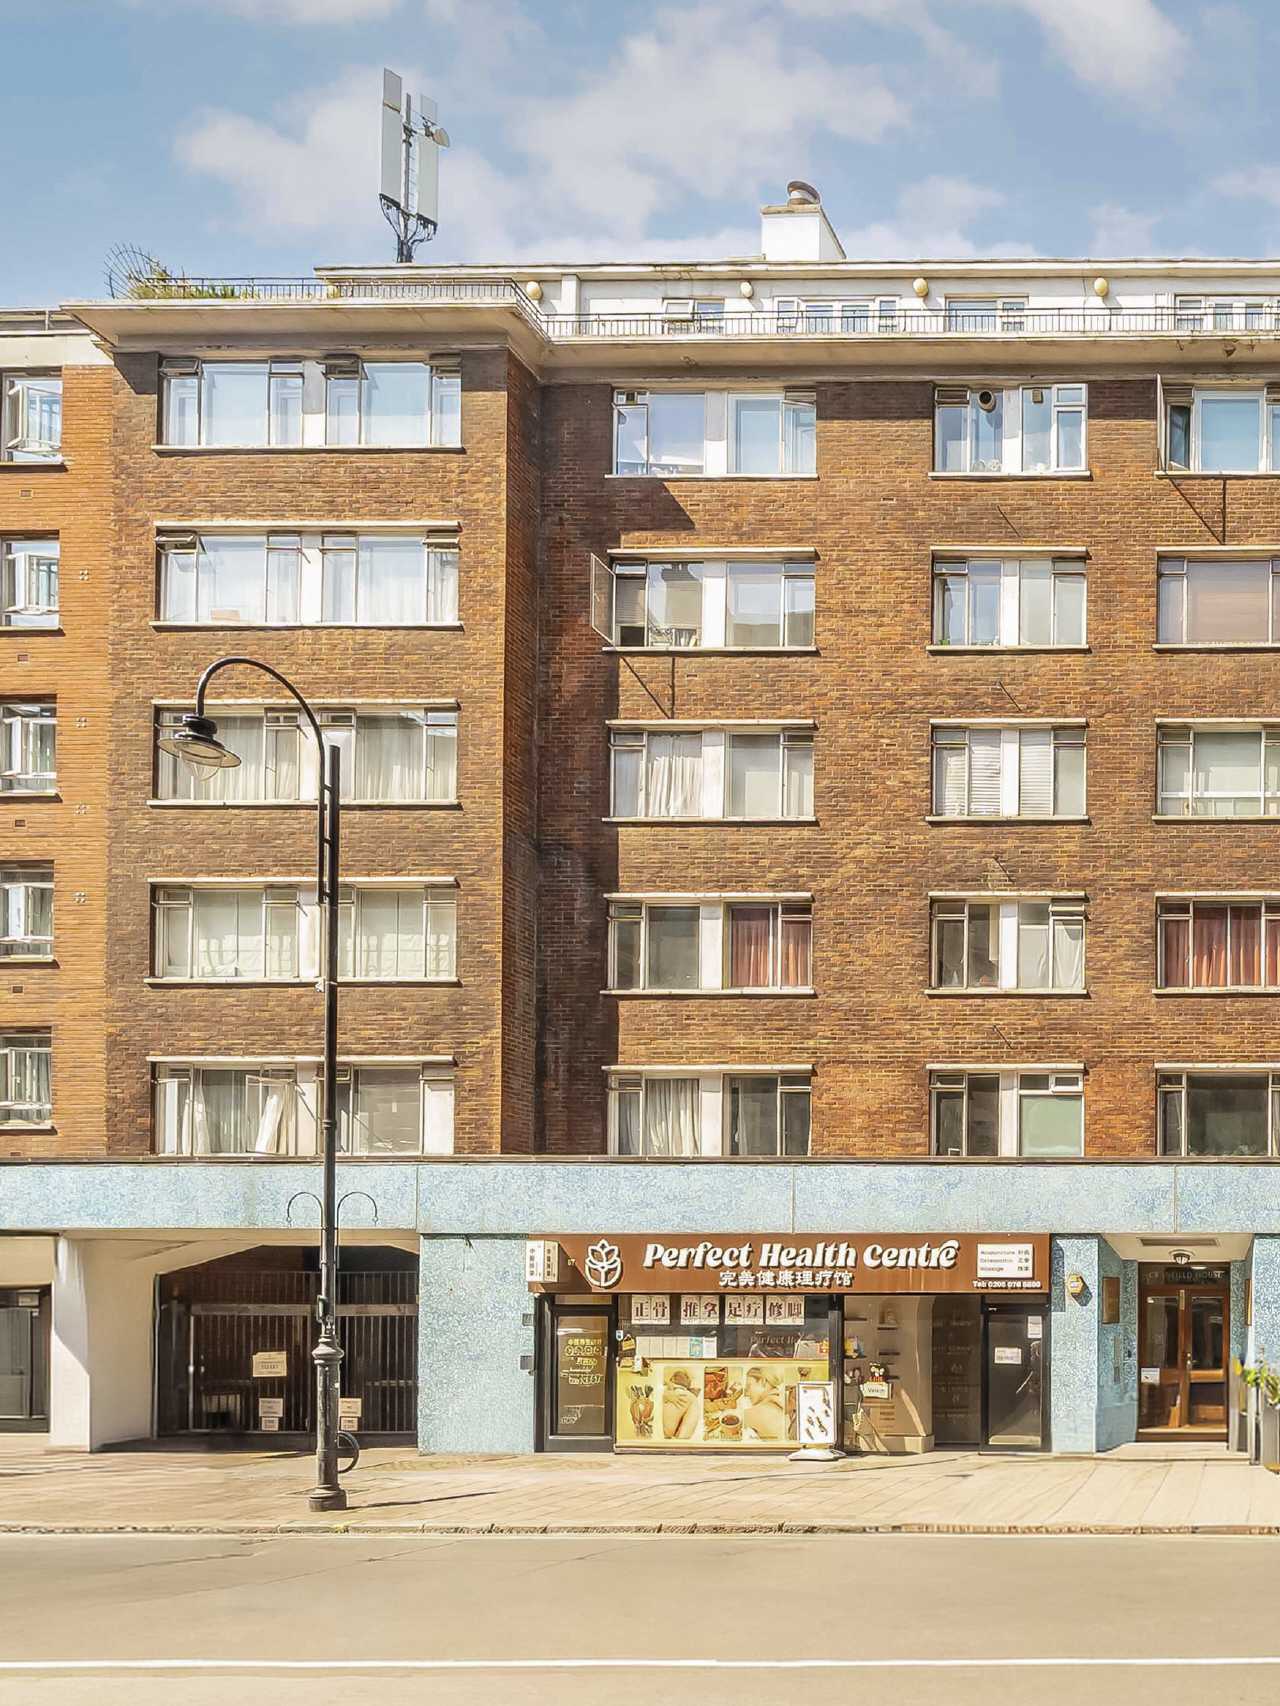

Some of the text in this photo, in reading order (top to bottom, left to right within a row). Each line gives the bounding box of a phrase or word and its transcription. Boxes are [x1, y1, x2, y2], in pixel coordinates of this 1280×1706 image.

[643, 1239, 959, 1269] Perfect Health Centre
[635, 1301, 668, 1318] 正骨
[728, 1301, 762, 1318] 足疗
